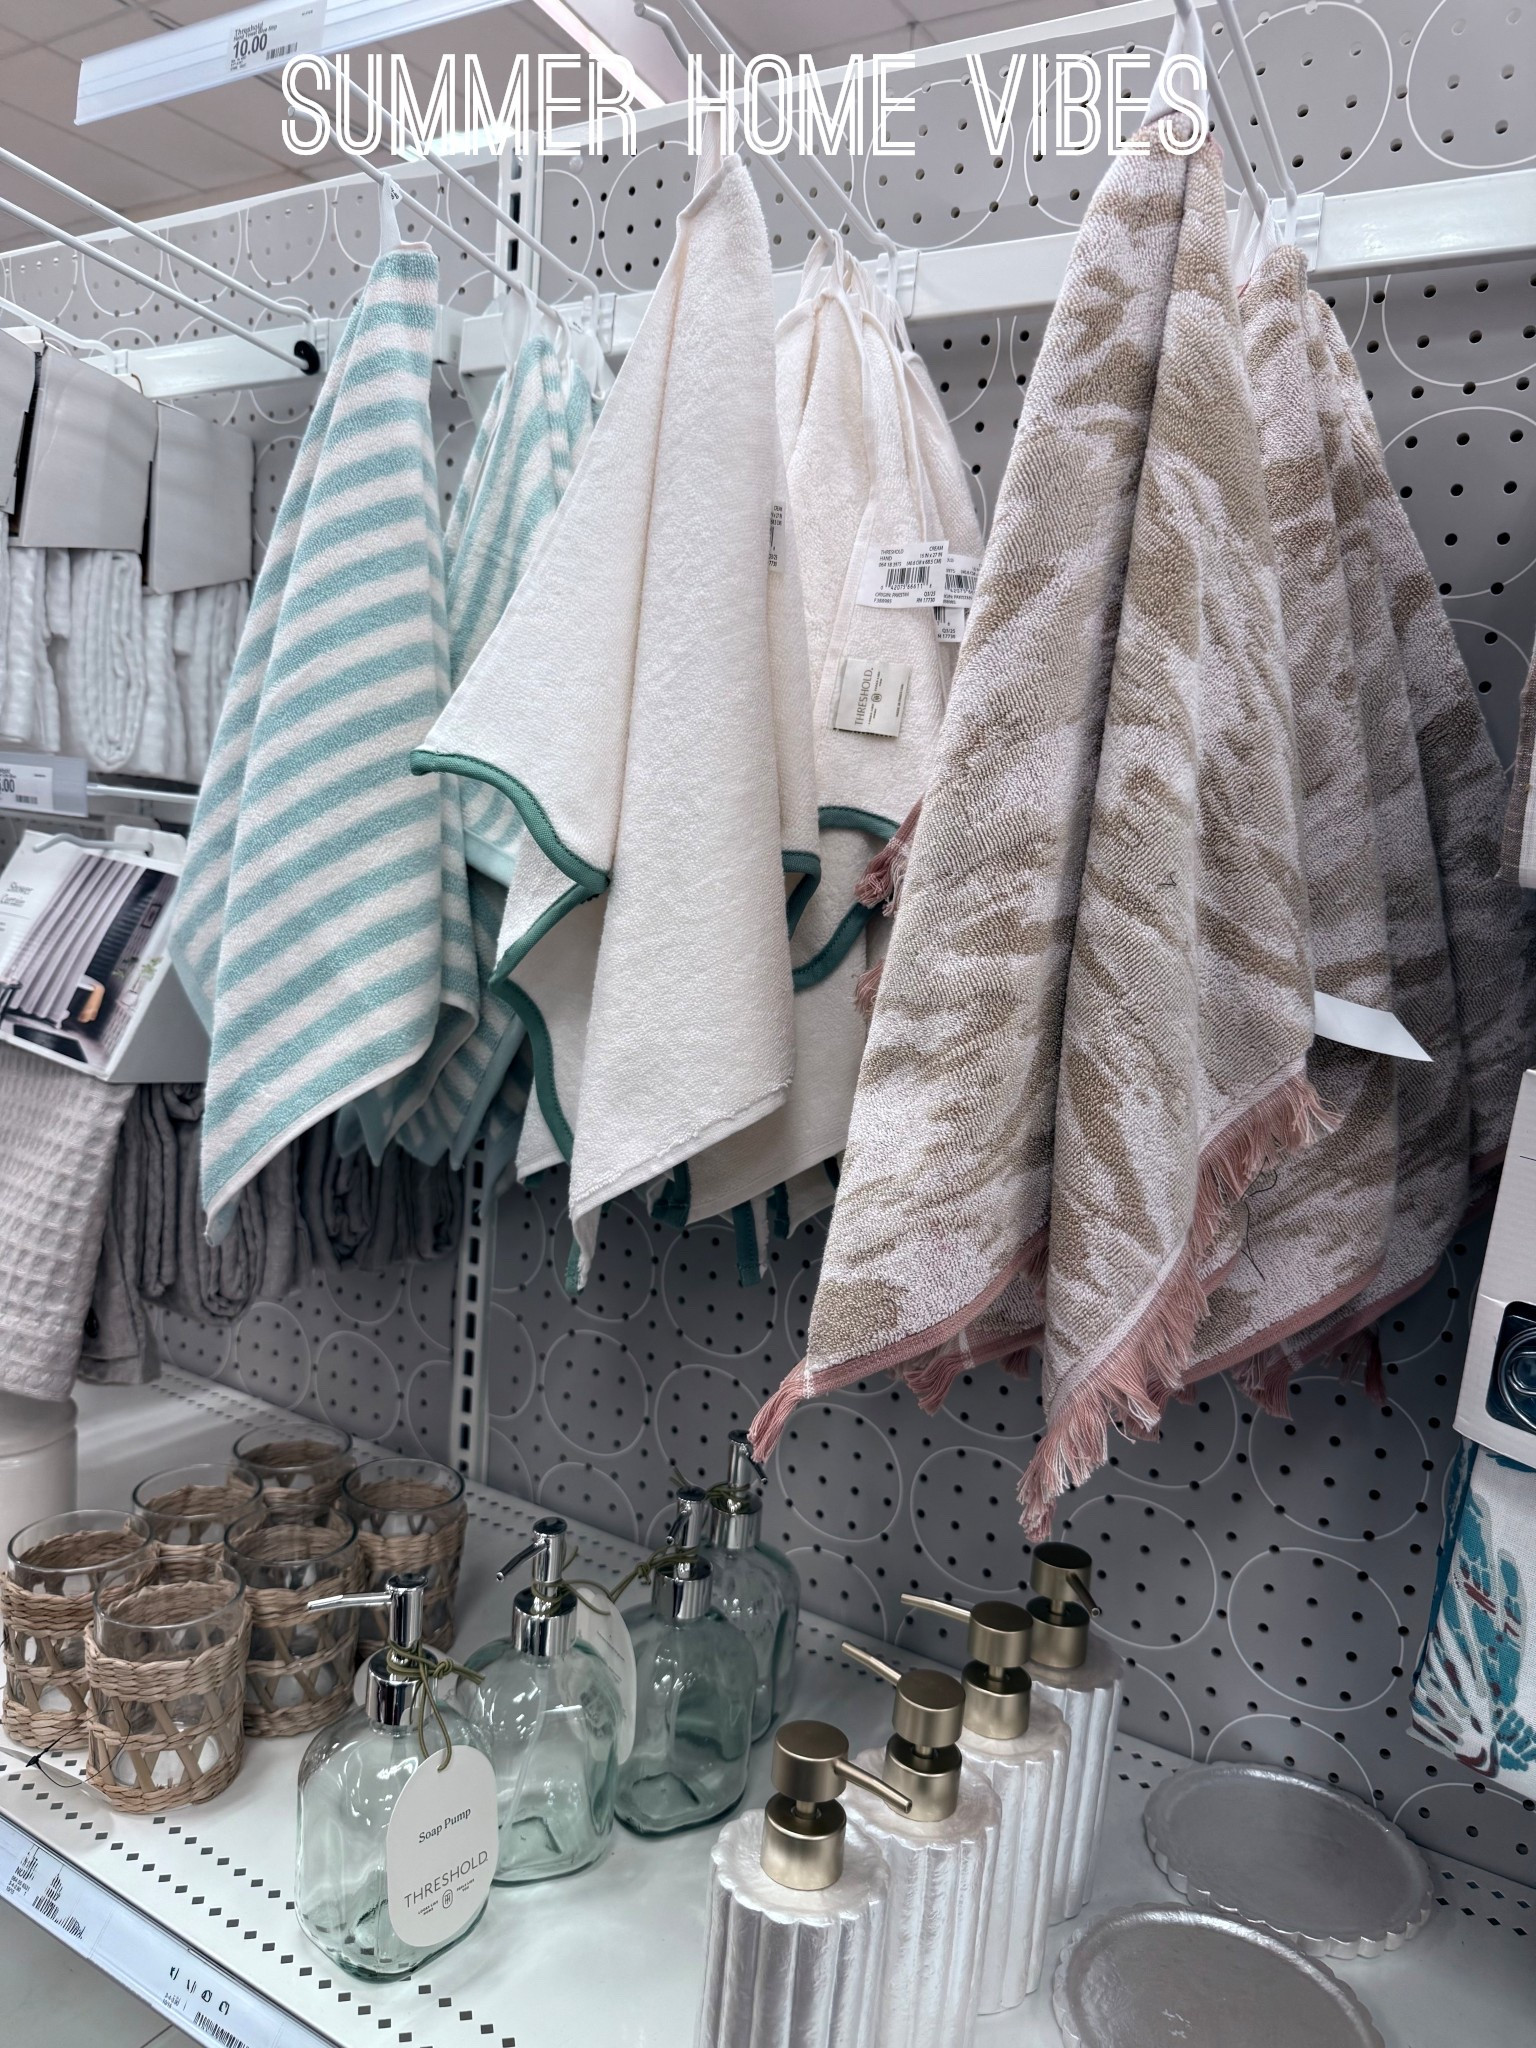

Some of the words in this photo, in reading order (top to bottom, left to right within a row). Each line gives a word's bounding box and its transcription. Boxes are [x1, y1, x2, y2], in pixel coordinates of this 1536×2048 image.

[233, 33, 268, 59] 10.00
[418, 1824, 443, 1844] Soap
[444, 1808, 471, 1830] Pump
